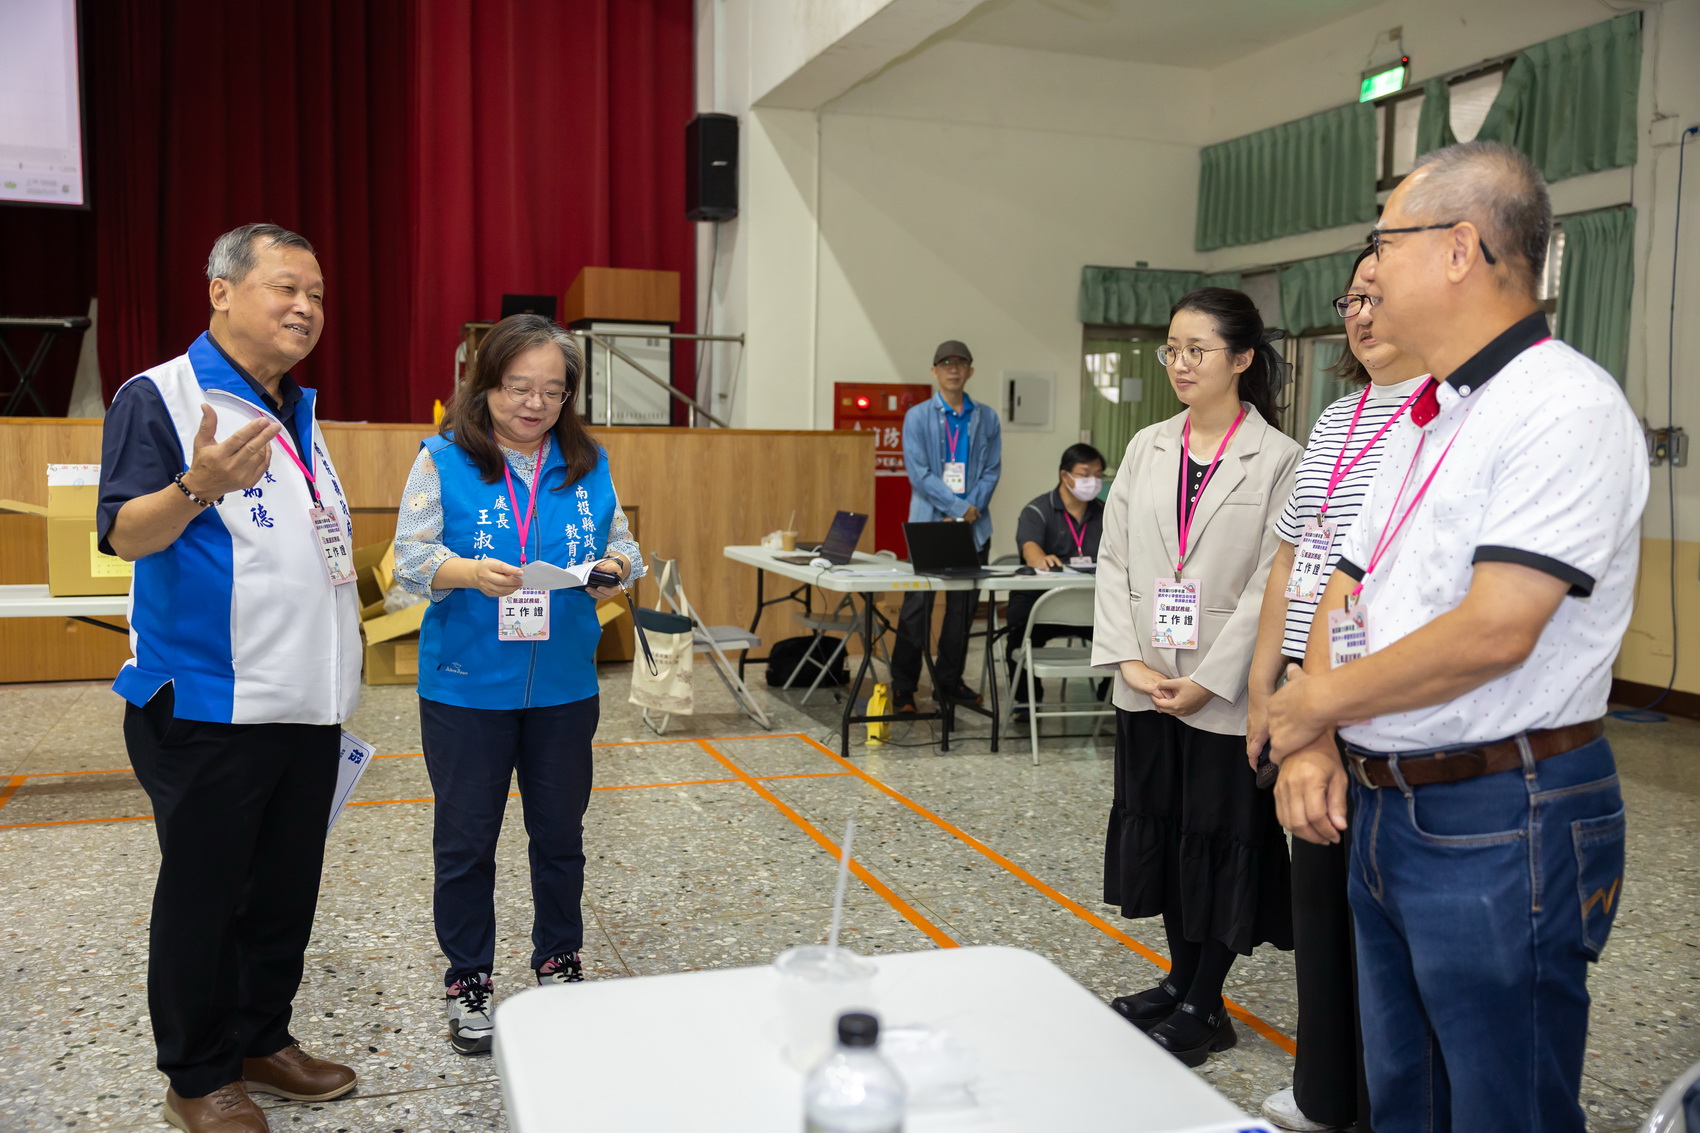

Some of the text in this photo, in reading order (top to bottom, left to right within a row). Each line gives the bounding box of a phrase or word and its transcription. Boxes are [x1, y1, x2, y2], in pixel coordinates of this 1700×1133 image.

[493, 495, 511, 529] 處長
[575, 485, 598, 563] 南投縣政府
[505, 606, 544, 617] 工作證
[1158, 614, 1193, 626] 工作證
